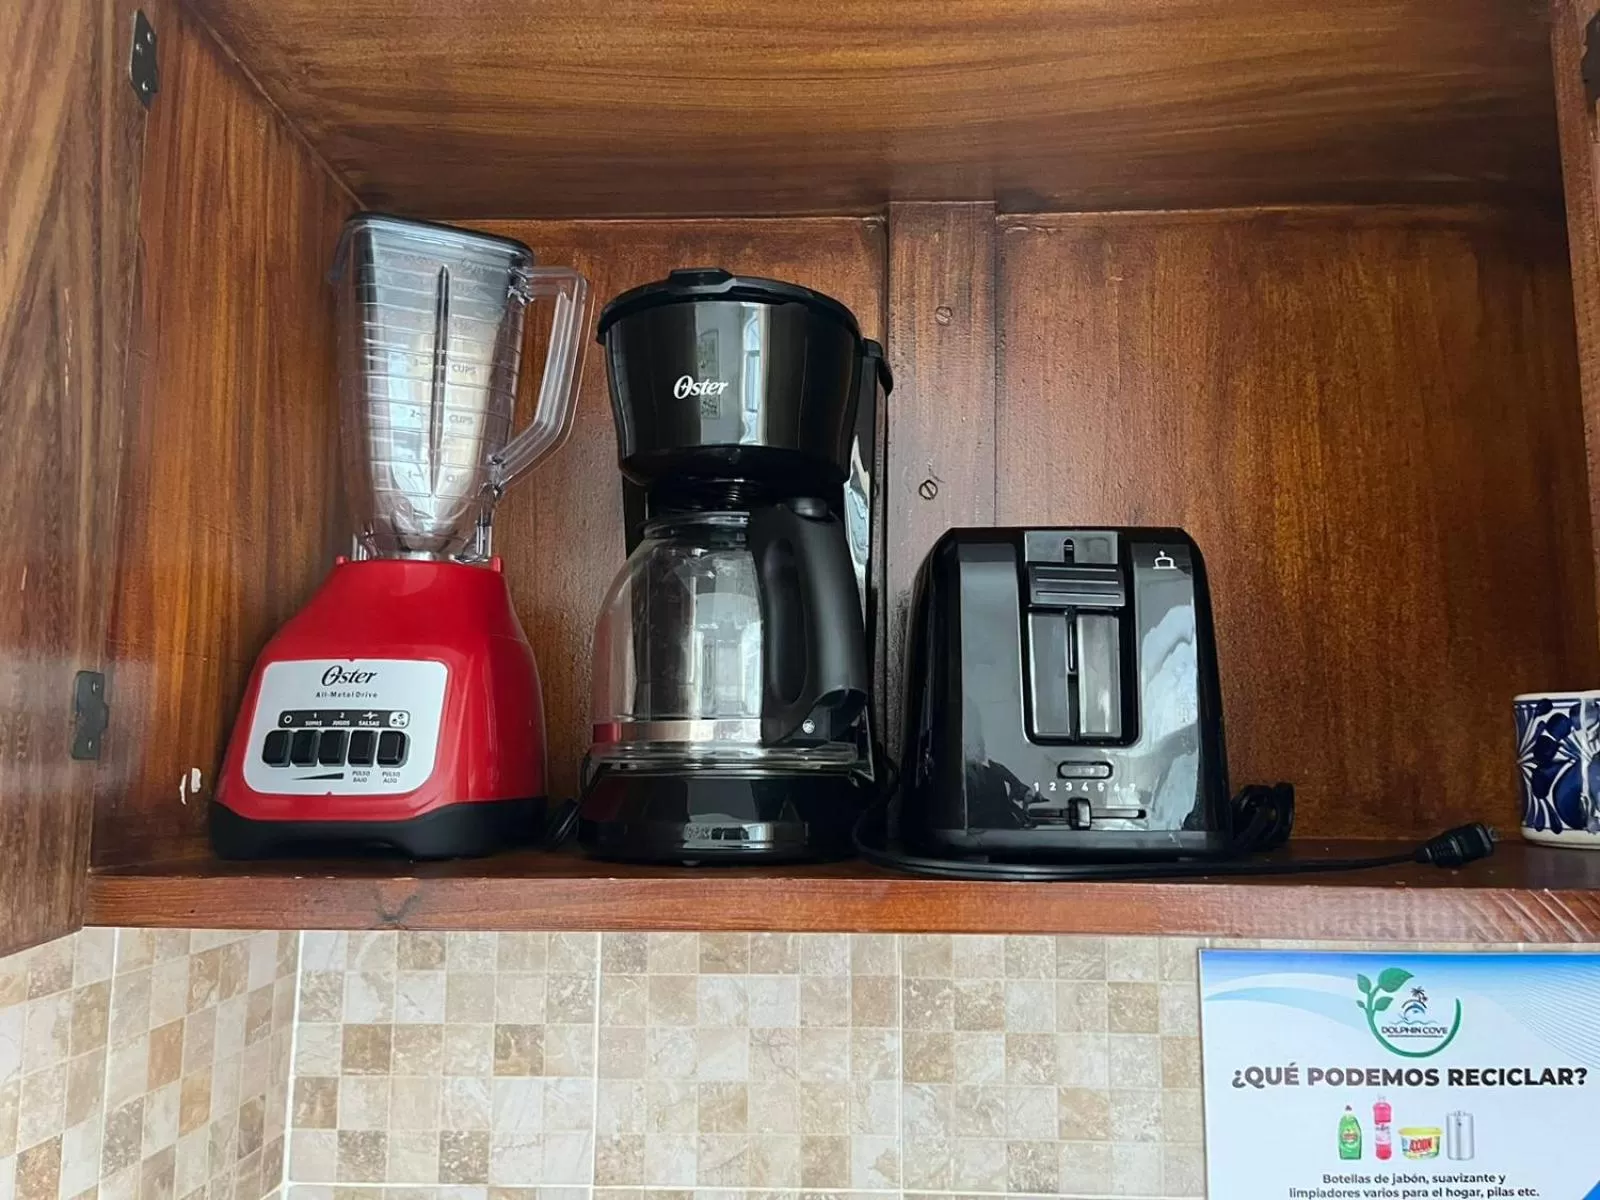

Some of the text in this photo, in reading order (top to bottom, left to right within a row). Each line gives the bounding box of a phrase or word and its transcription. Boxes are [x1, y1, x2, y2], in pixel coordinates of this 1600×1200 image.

[452, 364, 477, 375] CUPS
[673, 375, 729, 400] Oster
[449, 414, 474, 425] CUPS
[321, 665, 378, 687] Oster
[1033, 782, 1039, 792] 1
[1049, 782, 1056, 792] 2
[1065, 782, 1072, 792] 3
[1081, 782, 1089, 792] 4
[1097, 782, 1104, 792] 5
[1129, 783, 1136, 792] 7
[1381, 1026, 1448, 1034] DOLPHIN COVE
[1231, 1062, 1588, 1088] ¿QUÉ PODEMOS RECICLAR?
[1323, 1173, 1506, 1187] Botellas de jabón, suavizante y
[1289, 1187, 1541, 1200] limpiadores varios para el hogar, pilas etc.
